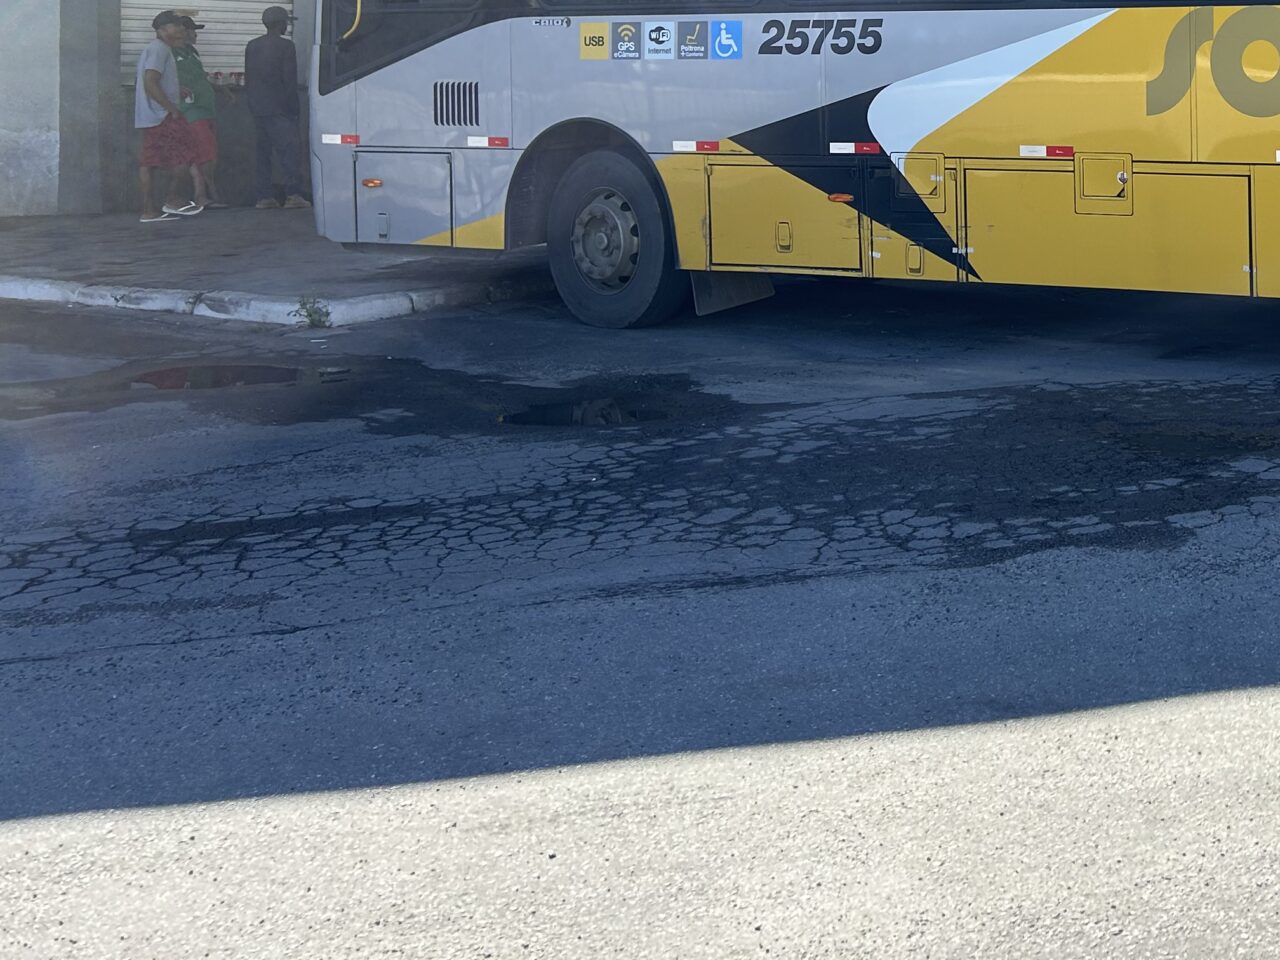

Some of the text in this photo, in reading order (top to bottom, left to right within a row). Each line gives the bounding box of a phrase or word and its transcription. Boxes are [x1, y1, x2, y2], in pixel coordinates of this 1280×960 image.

[584, 35, 605, 47] USB
[758, 18, 884, 55] 25755
[617, 42, 635, 51] GPS
